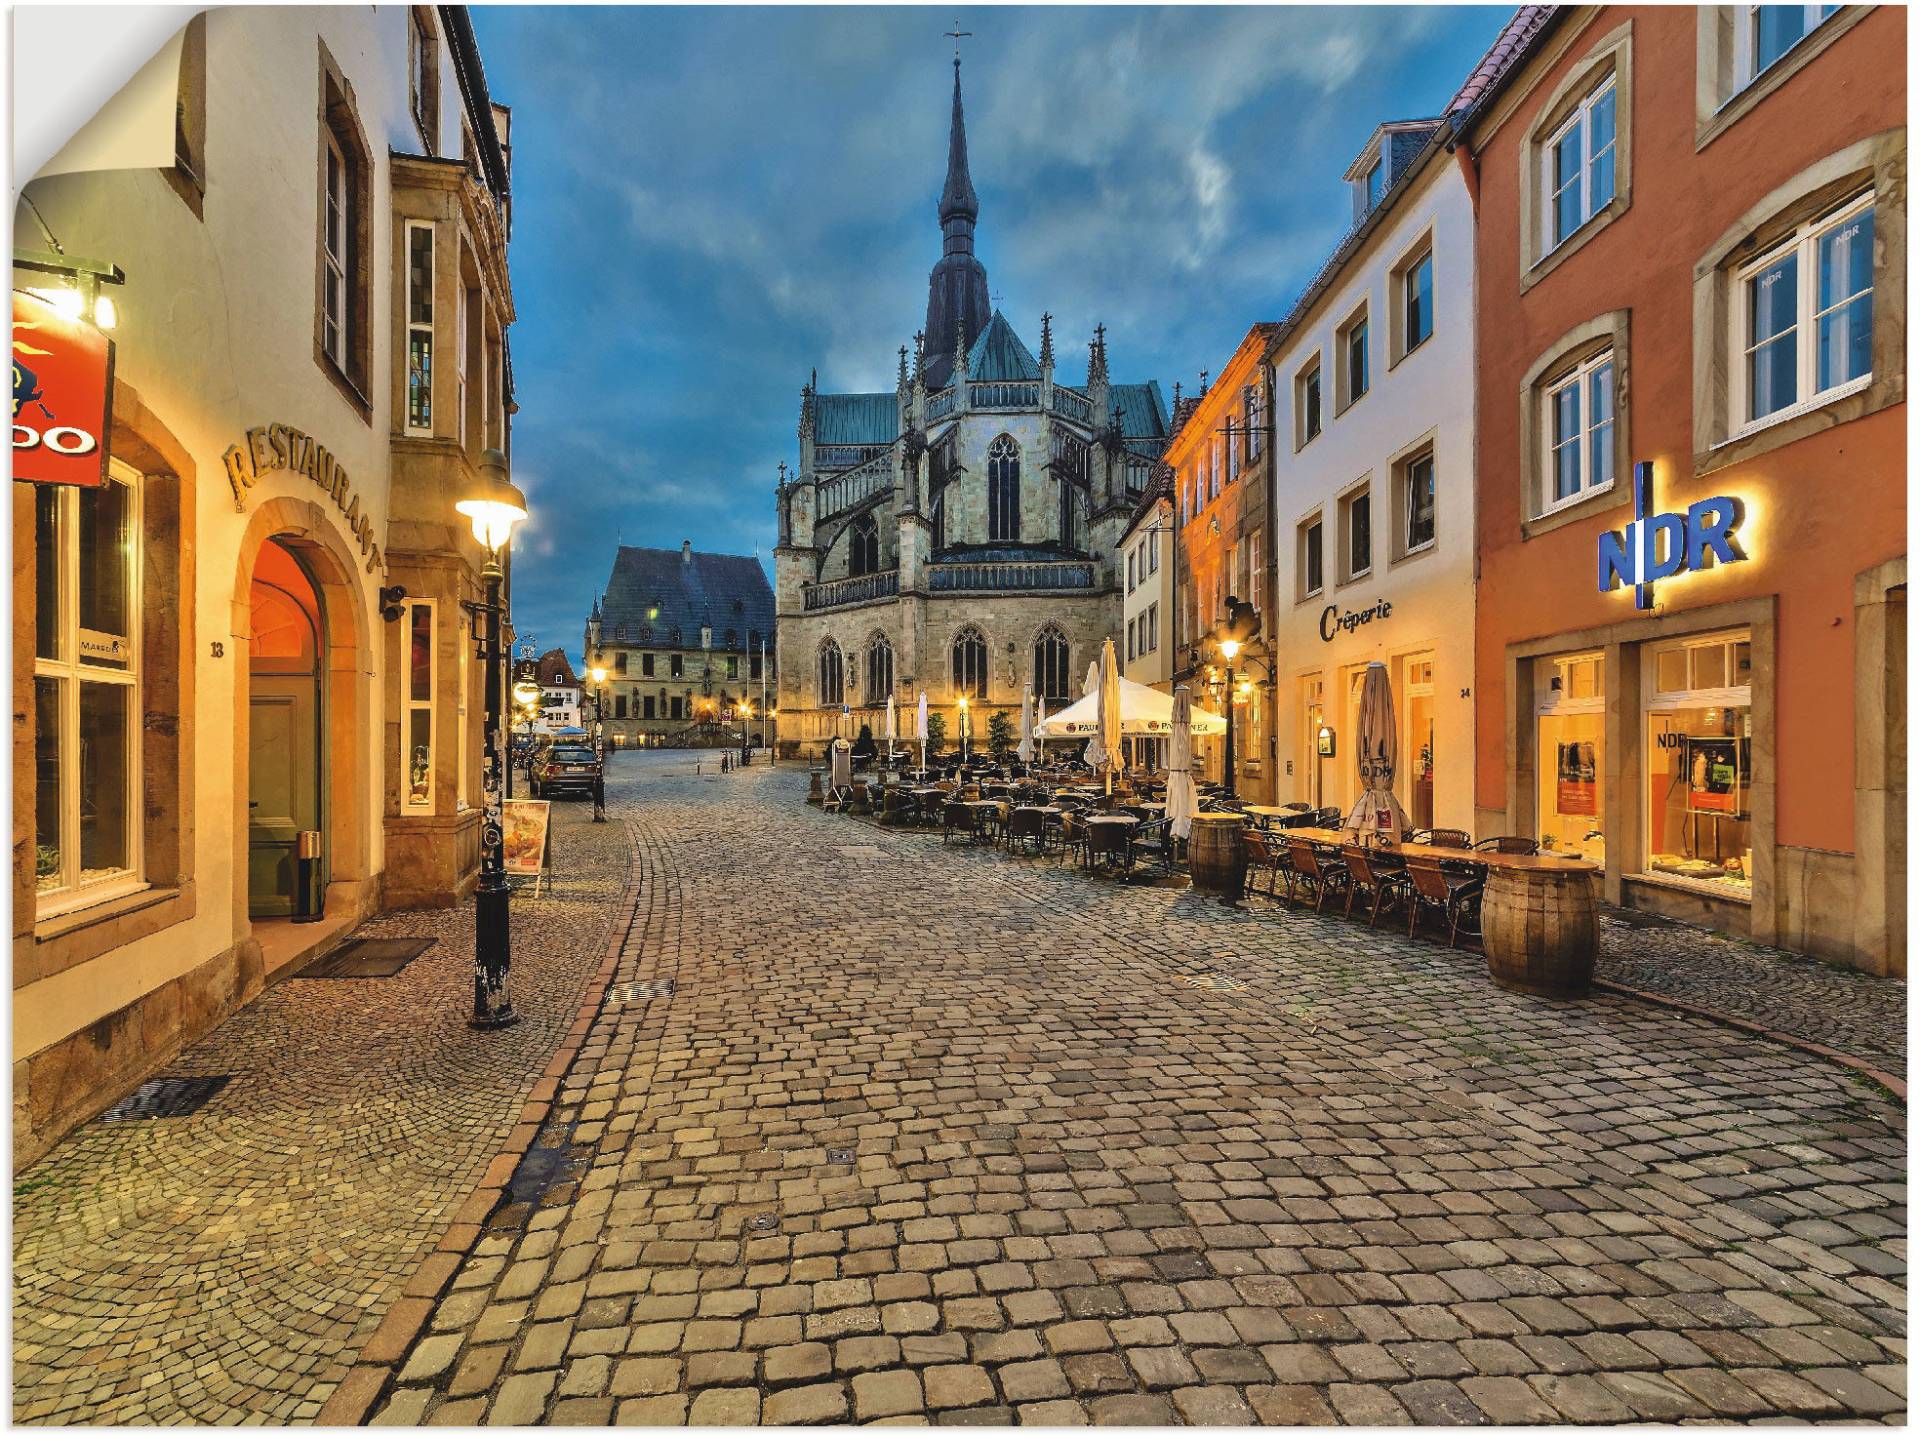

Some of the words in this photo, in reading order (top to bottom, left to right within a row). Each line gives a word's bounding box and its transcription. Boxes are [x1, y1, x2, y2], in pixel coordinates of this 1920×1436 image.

[221, 422, 383, 574] RESTAURANT
[1598, 495, 1743, 593] NDR
[210, 641, 224, 658] 13
[1319, 598, 1393, 643] Crêperie
